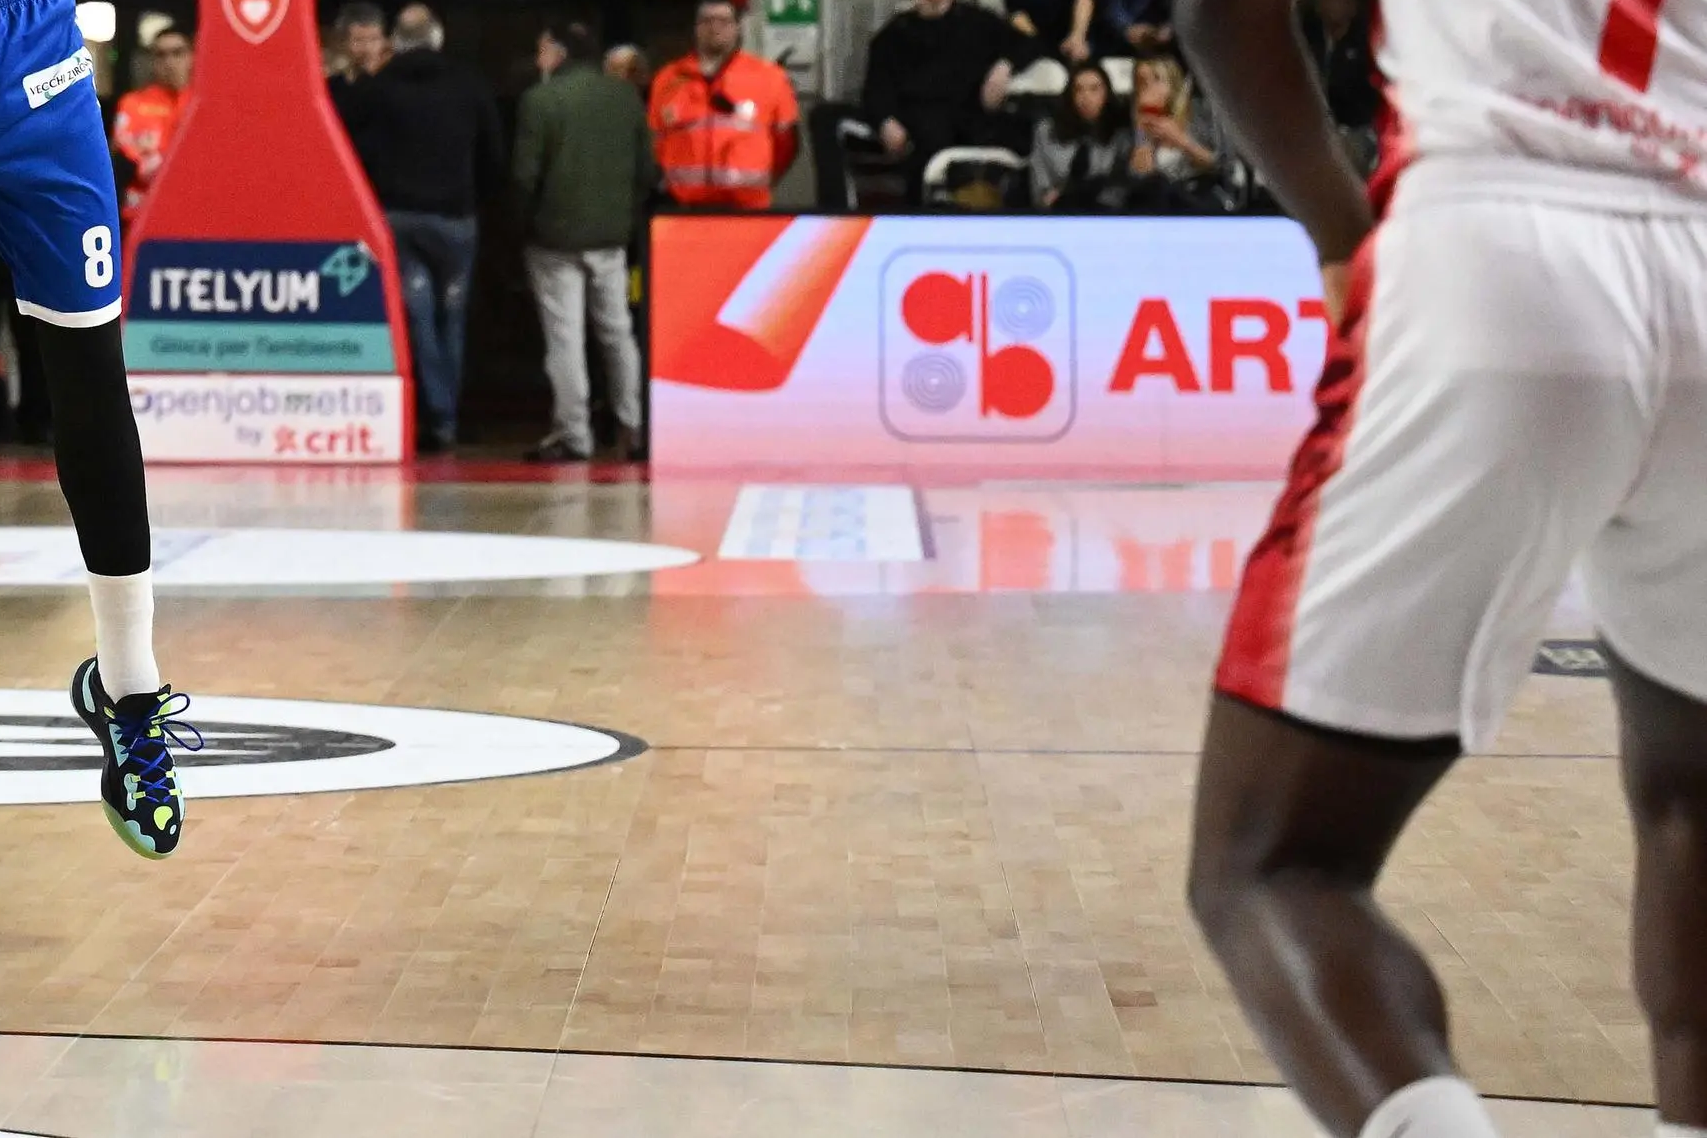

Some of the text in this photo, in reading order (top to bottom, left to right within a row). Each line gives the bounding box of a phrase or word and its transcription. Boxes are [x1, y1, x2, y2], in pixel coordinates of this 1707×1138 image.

[29, 73, 66, 95] VECCHI
[81, 225, 114, 288] 8
[149, 268, 321, 312] ITELYUM
